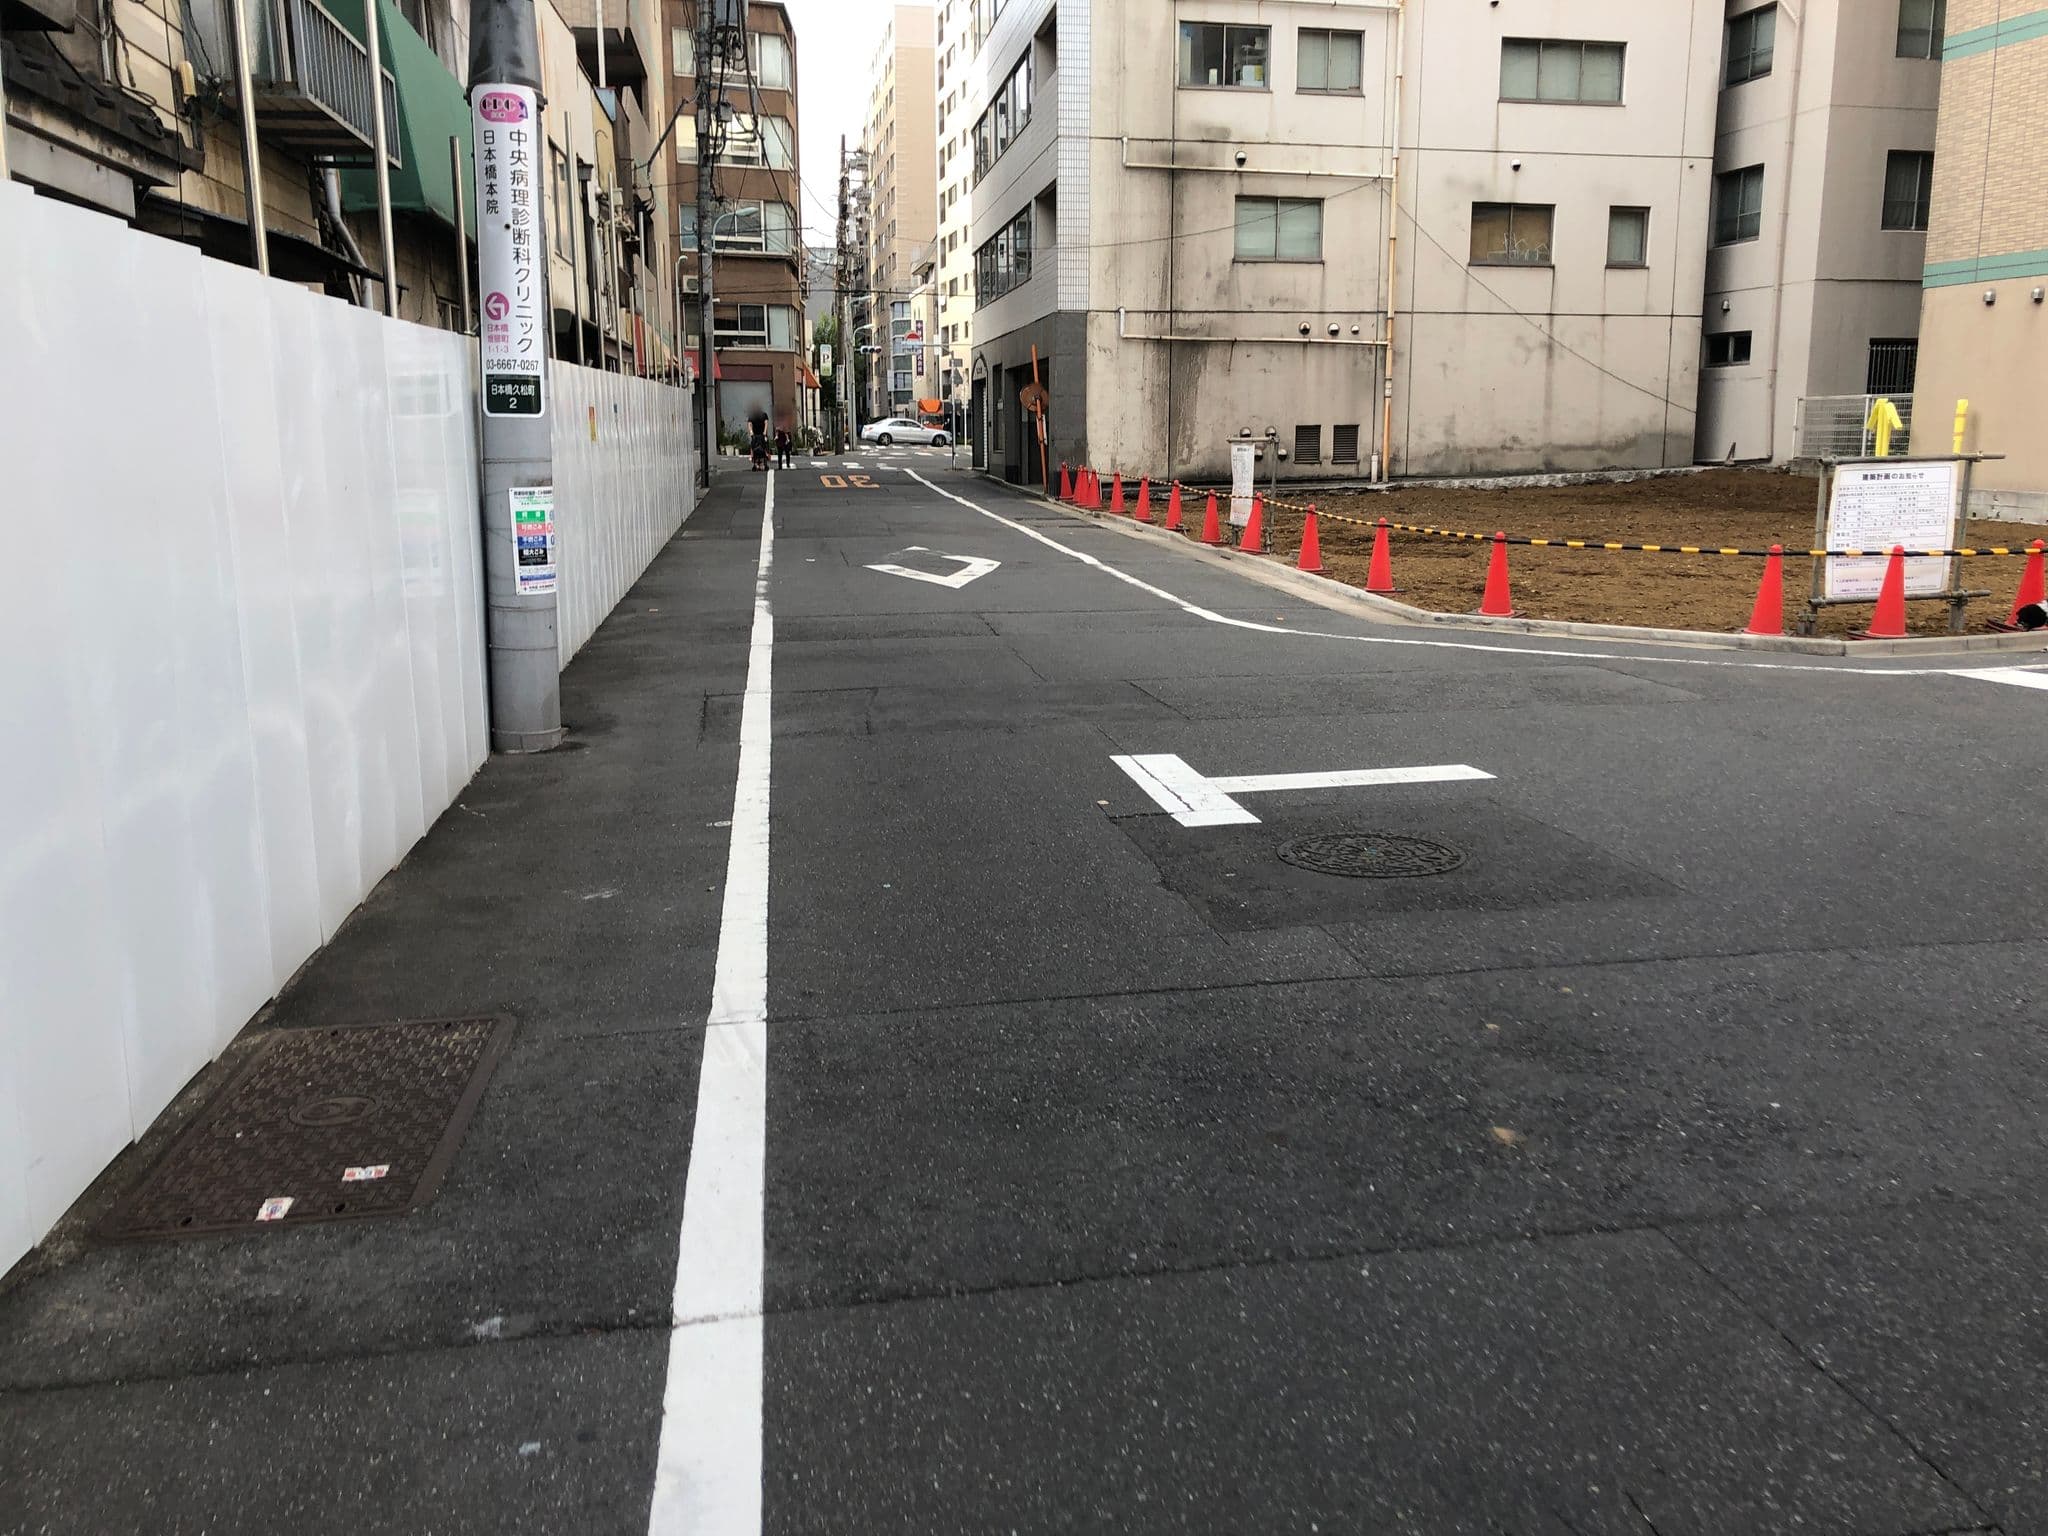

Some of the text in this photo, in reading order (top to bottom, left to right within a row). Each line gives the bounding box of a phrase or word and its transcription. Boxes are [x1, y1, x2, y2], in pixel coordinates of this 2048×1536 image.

[483, 129, 499, 215] 日本橋本院
[509, 129, 533, 353] 中央病理診断科クリニック
[823, 353, 830, 364] P
[486, 359, 539, 371] 03-6667-0267
[491, 384, 535, 397] 日本橋久松町
[509, 397, 517, 409] 2
[820, 474, 880, 488] 30
[1862, 472, 1925, 481] 建築計画のお知らせ
